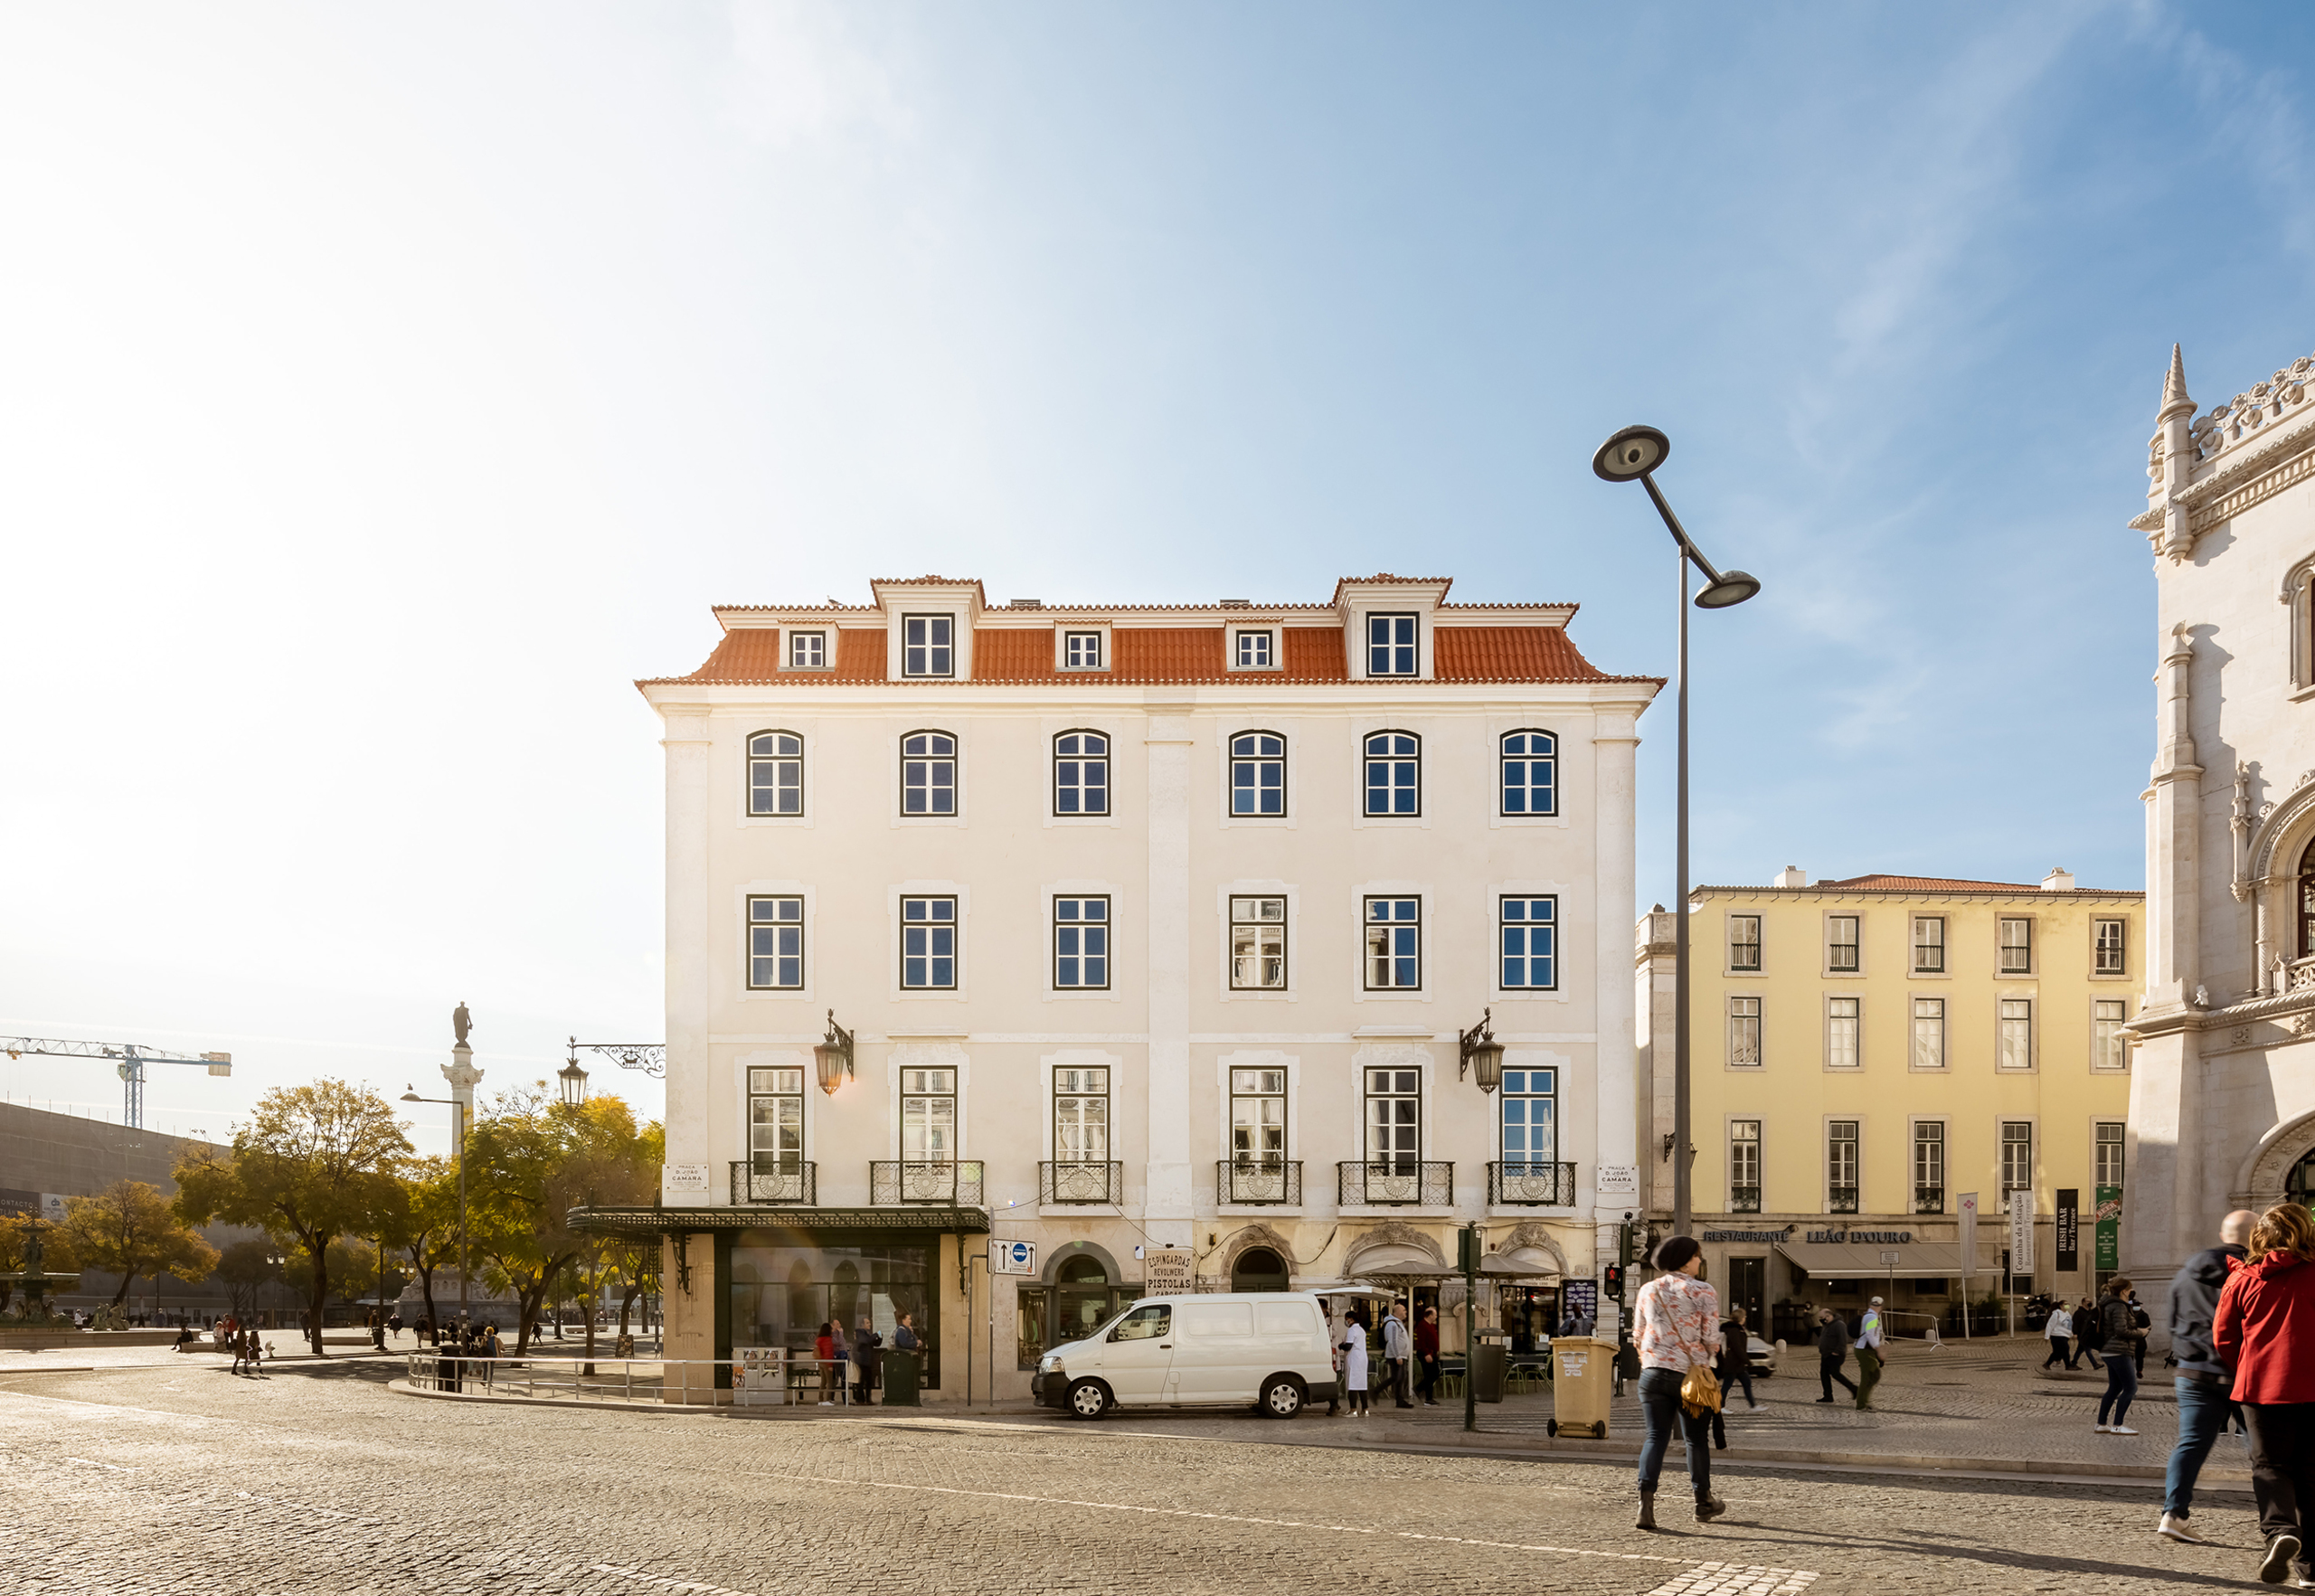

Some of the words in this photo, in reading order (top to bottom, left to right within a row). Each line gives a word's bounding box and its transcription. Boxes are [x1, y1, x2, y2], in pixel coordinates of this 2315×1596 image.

[2015, 1195, 2023, 1225] Estação
[2059, 1207, 2067, 1225] BAR
[2097, 1202, 2117, 1217] BEER
[1704, 1231, 1790, 1242] RESTAURANTE
[1851, 1231, 1913, 1243] D'OURO
[2015, 1227, 2022, 1237] da
[2059, 1227, 2067, 1251] IRISH
[1148, 1254, 1190, 1268] ESPINGARDAS
[2015, 1239, 2023, 1270] Cozinha
[1154, 1268, 1185, 1276] REVOLWERS
[1148, 1279, 1191, 1289] PISTOLAS
